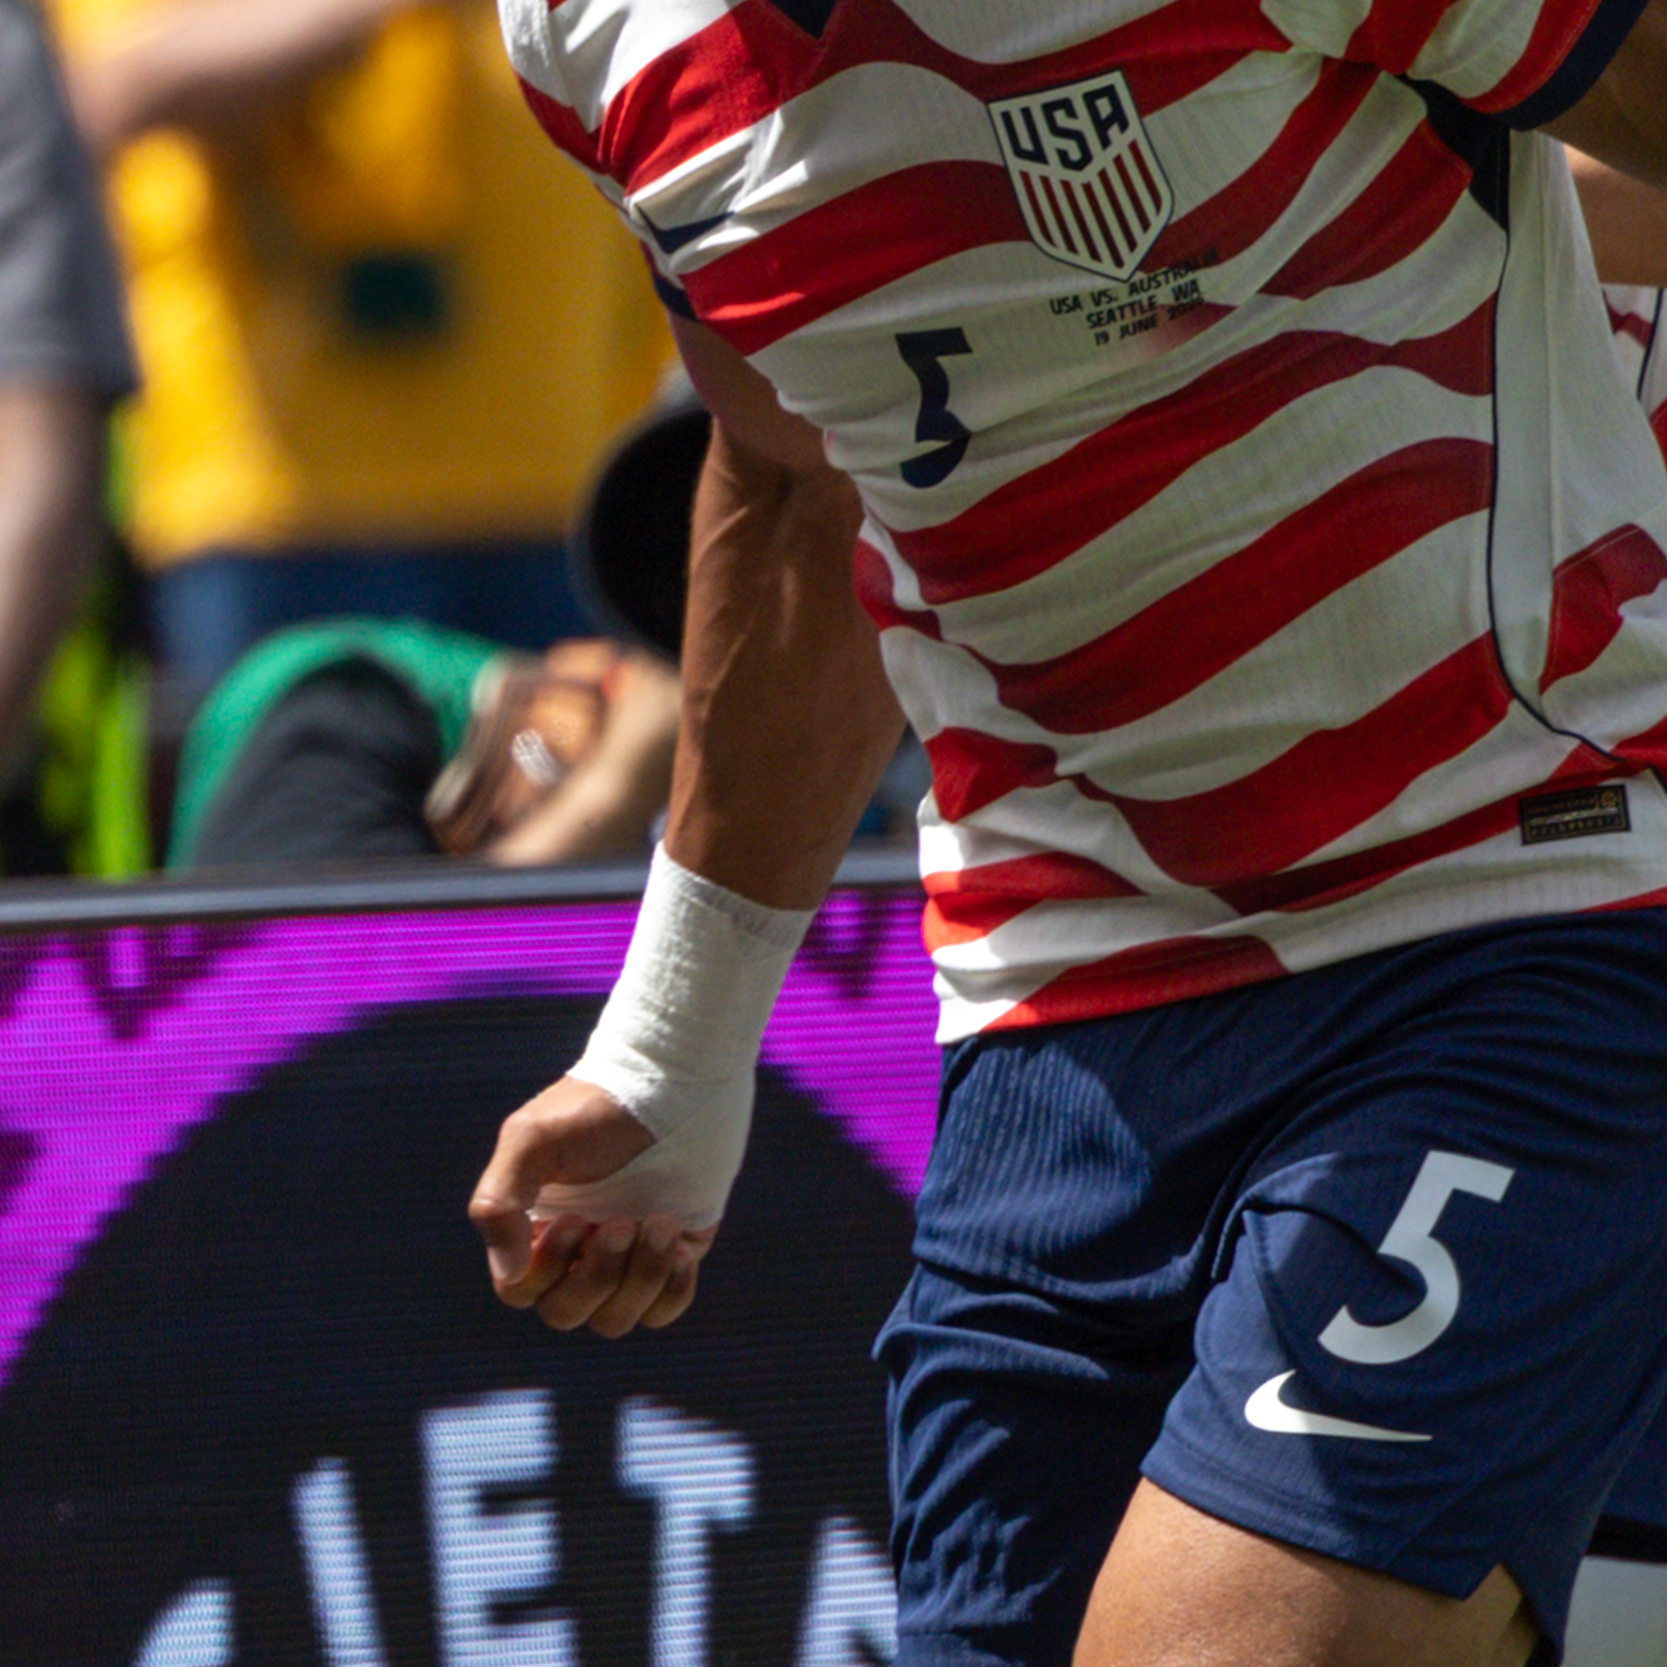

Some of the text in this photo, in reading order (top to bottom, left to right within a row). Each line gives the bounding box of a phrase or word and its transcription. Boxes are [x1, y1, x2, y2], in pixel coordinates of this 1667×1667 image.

[1000, 83, 1130, 172] USA
[1049, 293, 1083, 316] USA
[1090, 288, 1120, 308] VS.
[1171, 277, 1202, 303] WA
[1094, 330, 1111, 347] 19
[1119, 314, 1159, 340] JUNE
[895, 326, 973, 489] 5
[1318, 1149, 1516, 1365] 5
